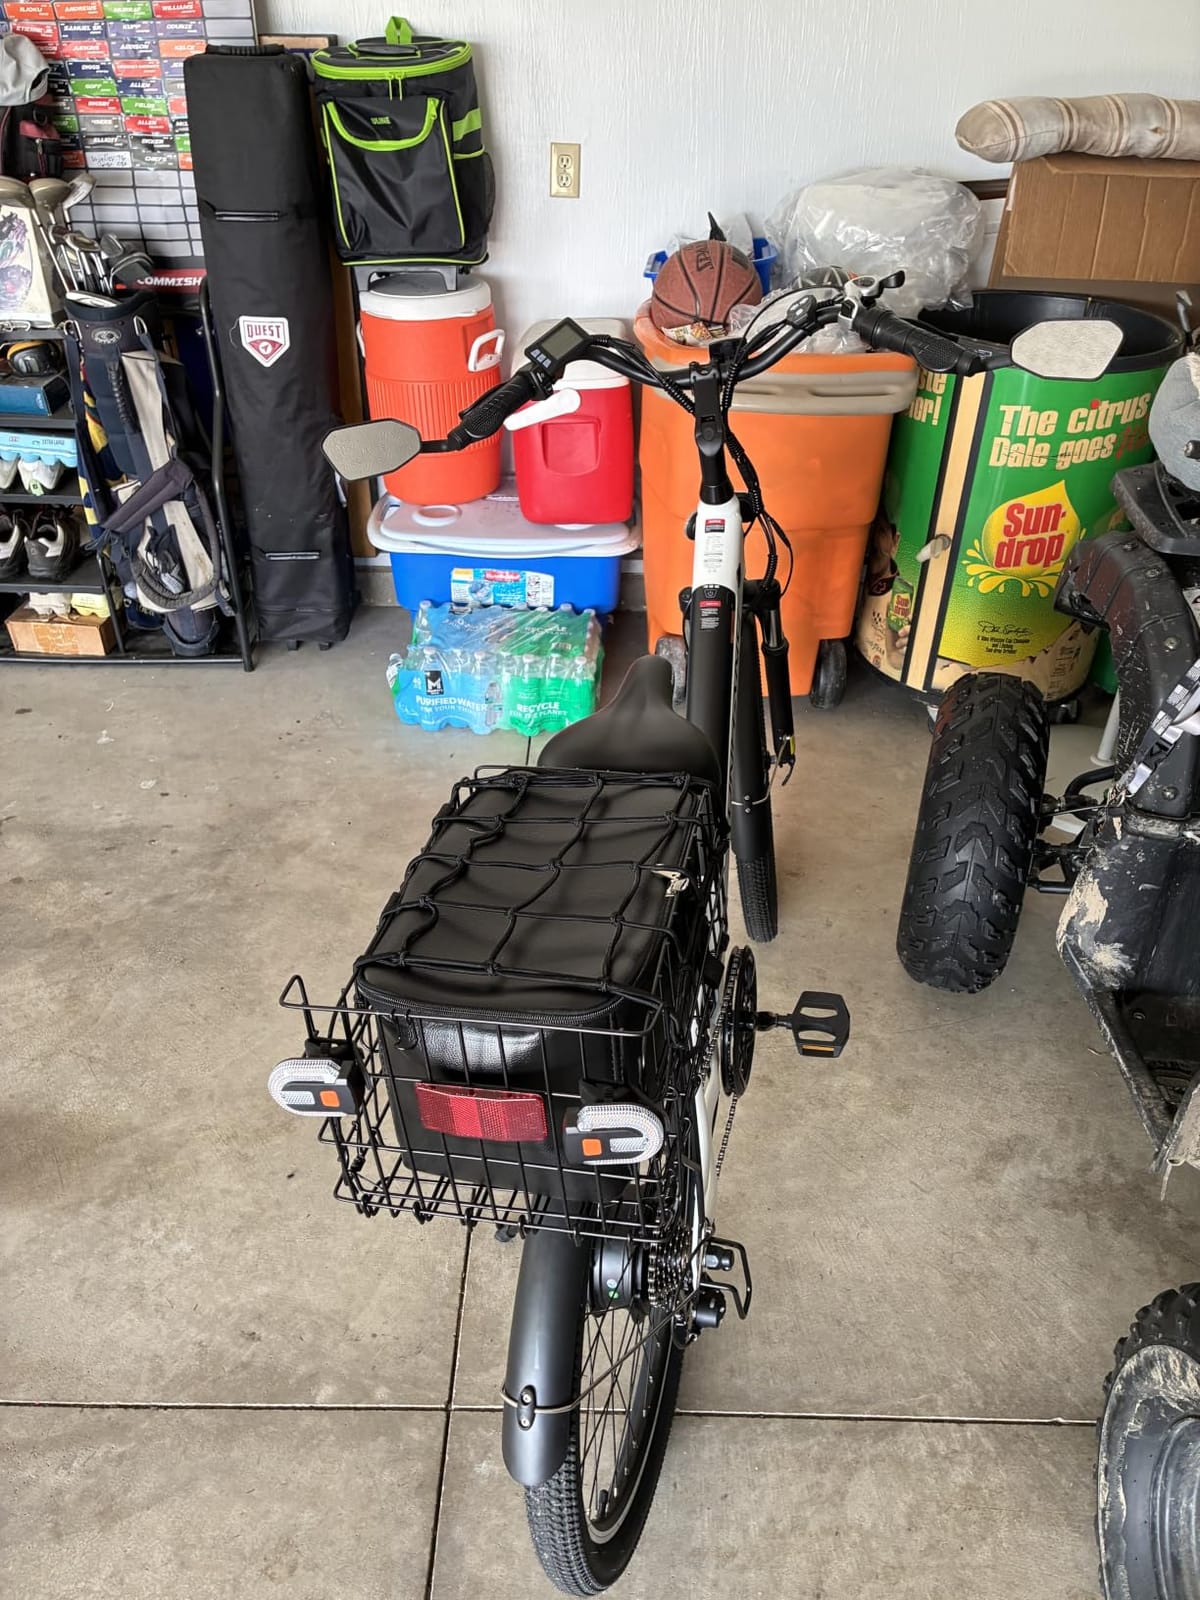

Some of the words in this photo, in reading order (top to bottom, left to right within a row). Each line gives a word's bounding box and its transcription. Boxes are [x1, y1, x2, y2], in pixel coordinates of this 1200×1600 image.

[246, 323, 281, 338] QUEST
[999, 405, 1059, 437] The
[1066, 393, 1151, 434] citrus
[988, 436, 1051, 468] Dale
[1055, 433, 1117, 470] goes
[994, 532, 1065, 569] drop
[416, 695, 457, 706] PURIFIED
[457, 697, 488, 712] WATER
[517, 701, 560, 713] RECYCLE
[539, 709, 568, 718] PLANET
